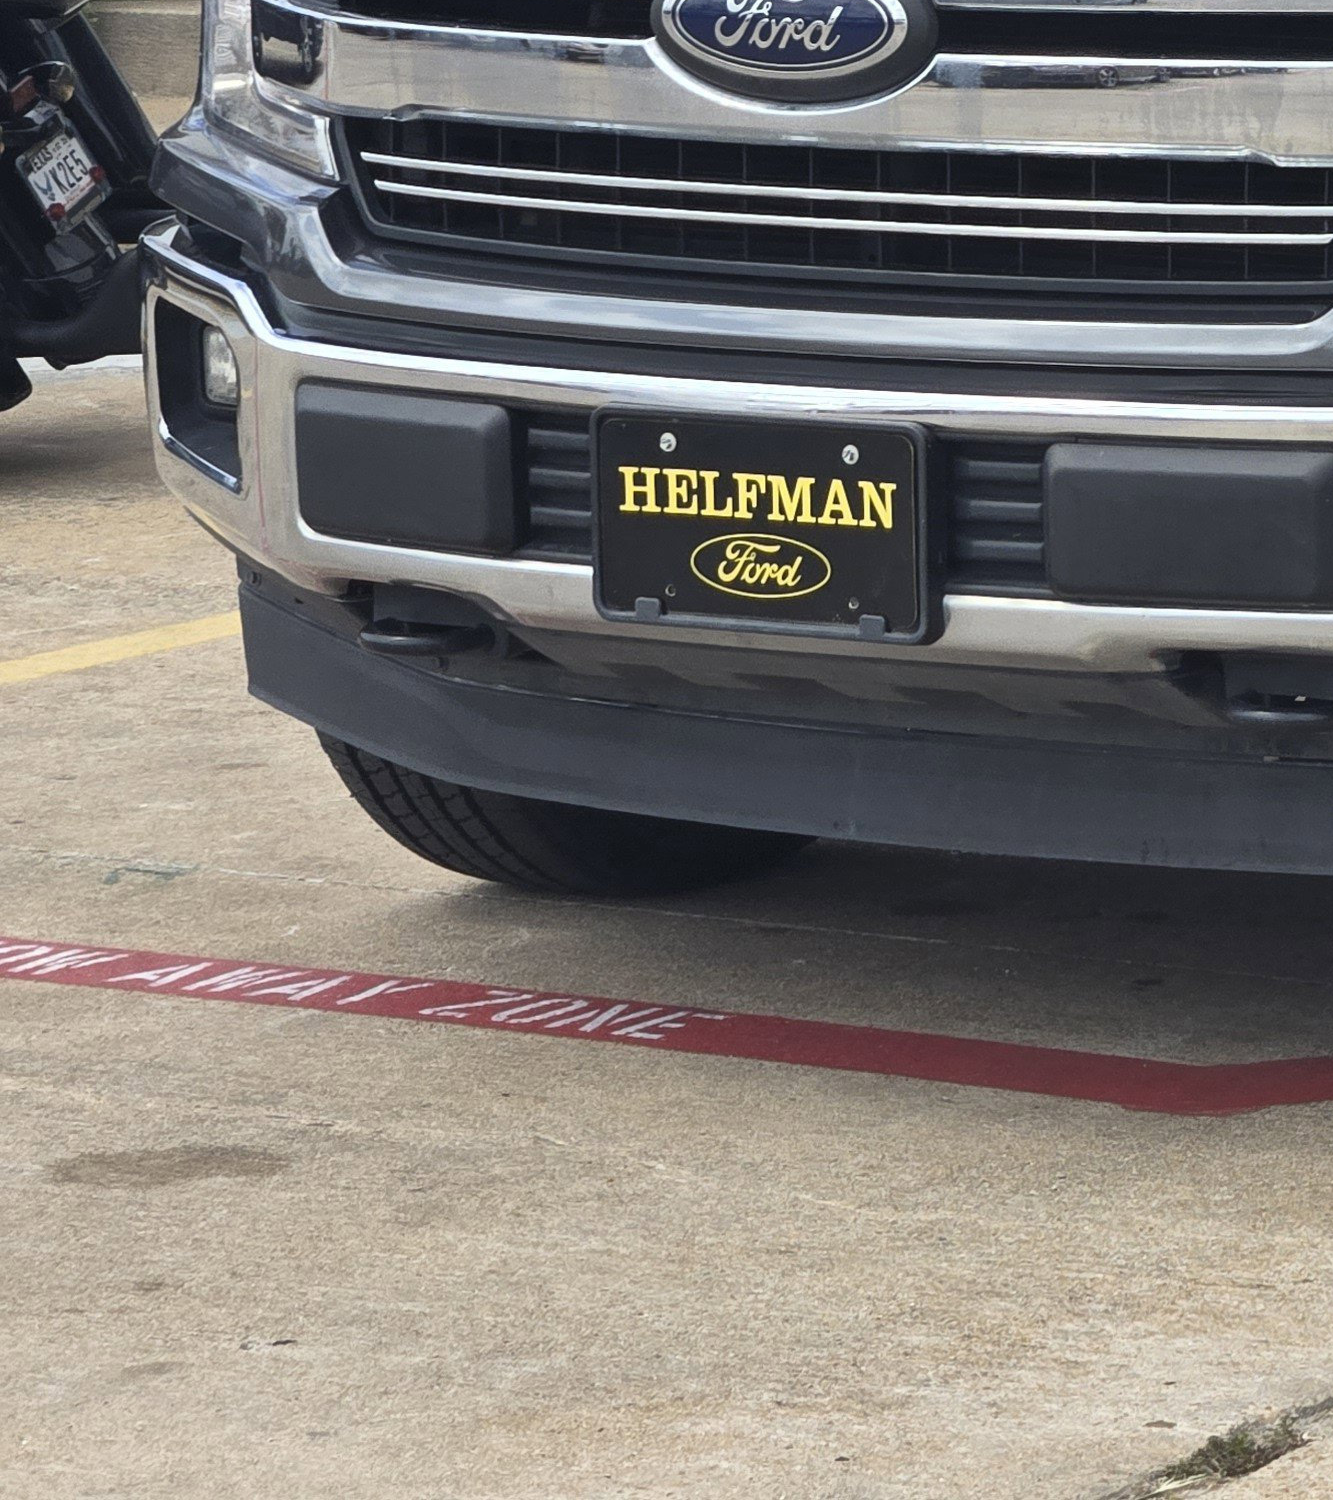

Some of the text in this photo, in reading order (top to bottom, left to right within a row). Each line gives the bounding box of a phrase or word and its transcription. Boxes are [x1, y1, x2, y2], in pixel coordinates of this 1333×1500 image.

[618, 466, 897, 529] HELFMAN
[717, 540, 803, 587] Ford
[103, 962, 434, 1005] AWAY
[418, 990, 726, 1040] ZONE
